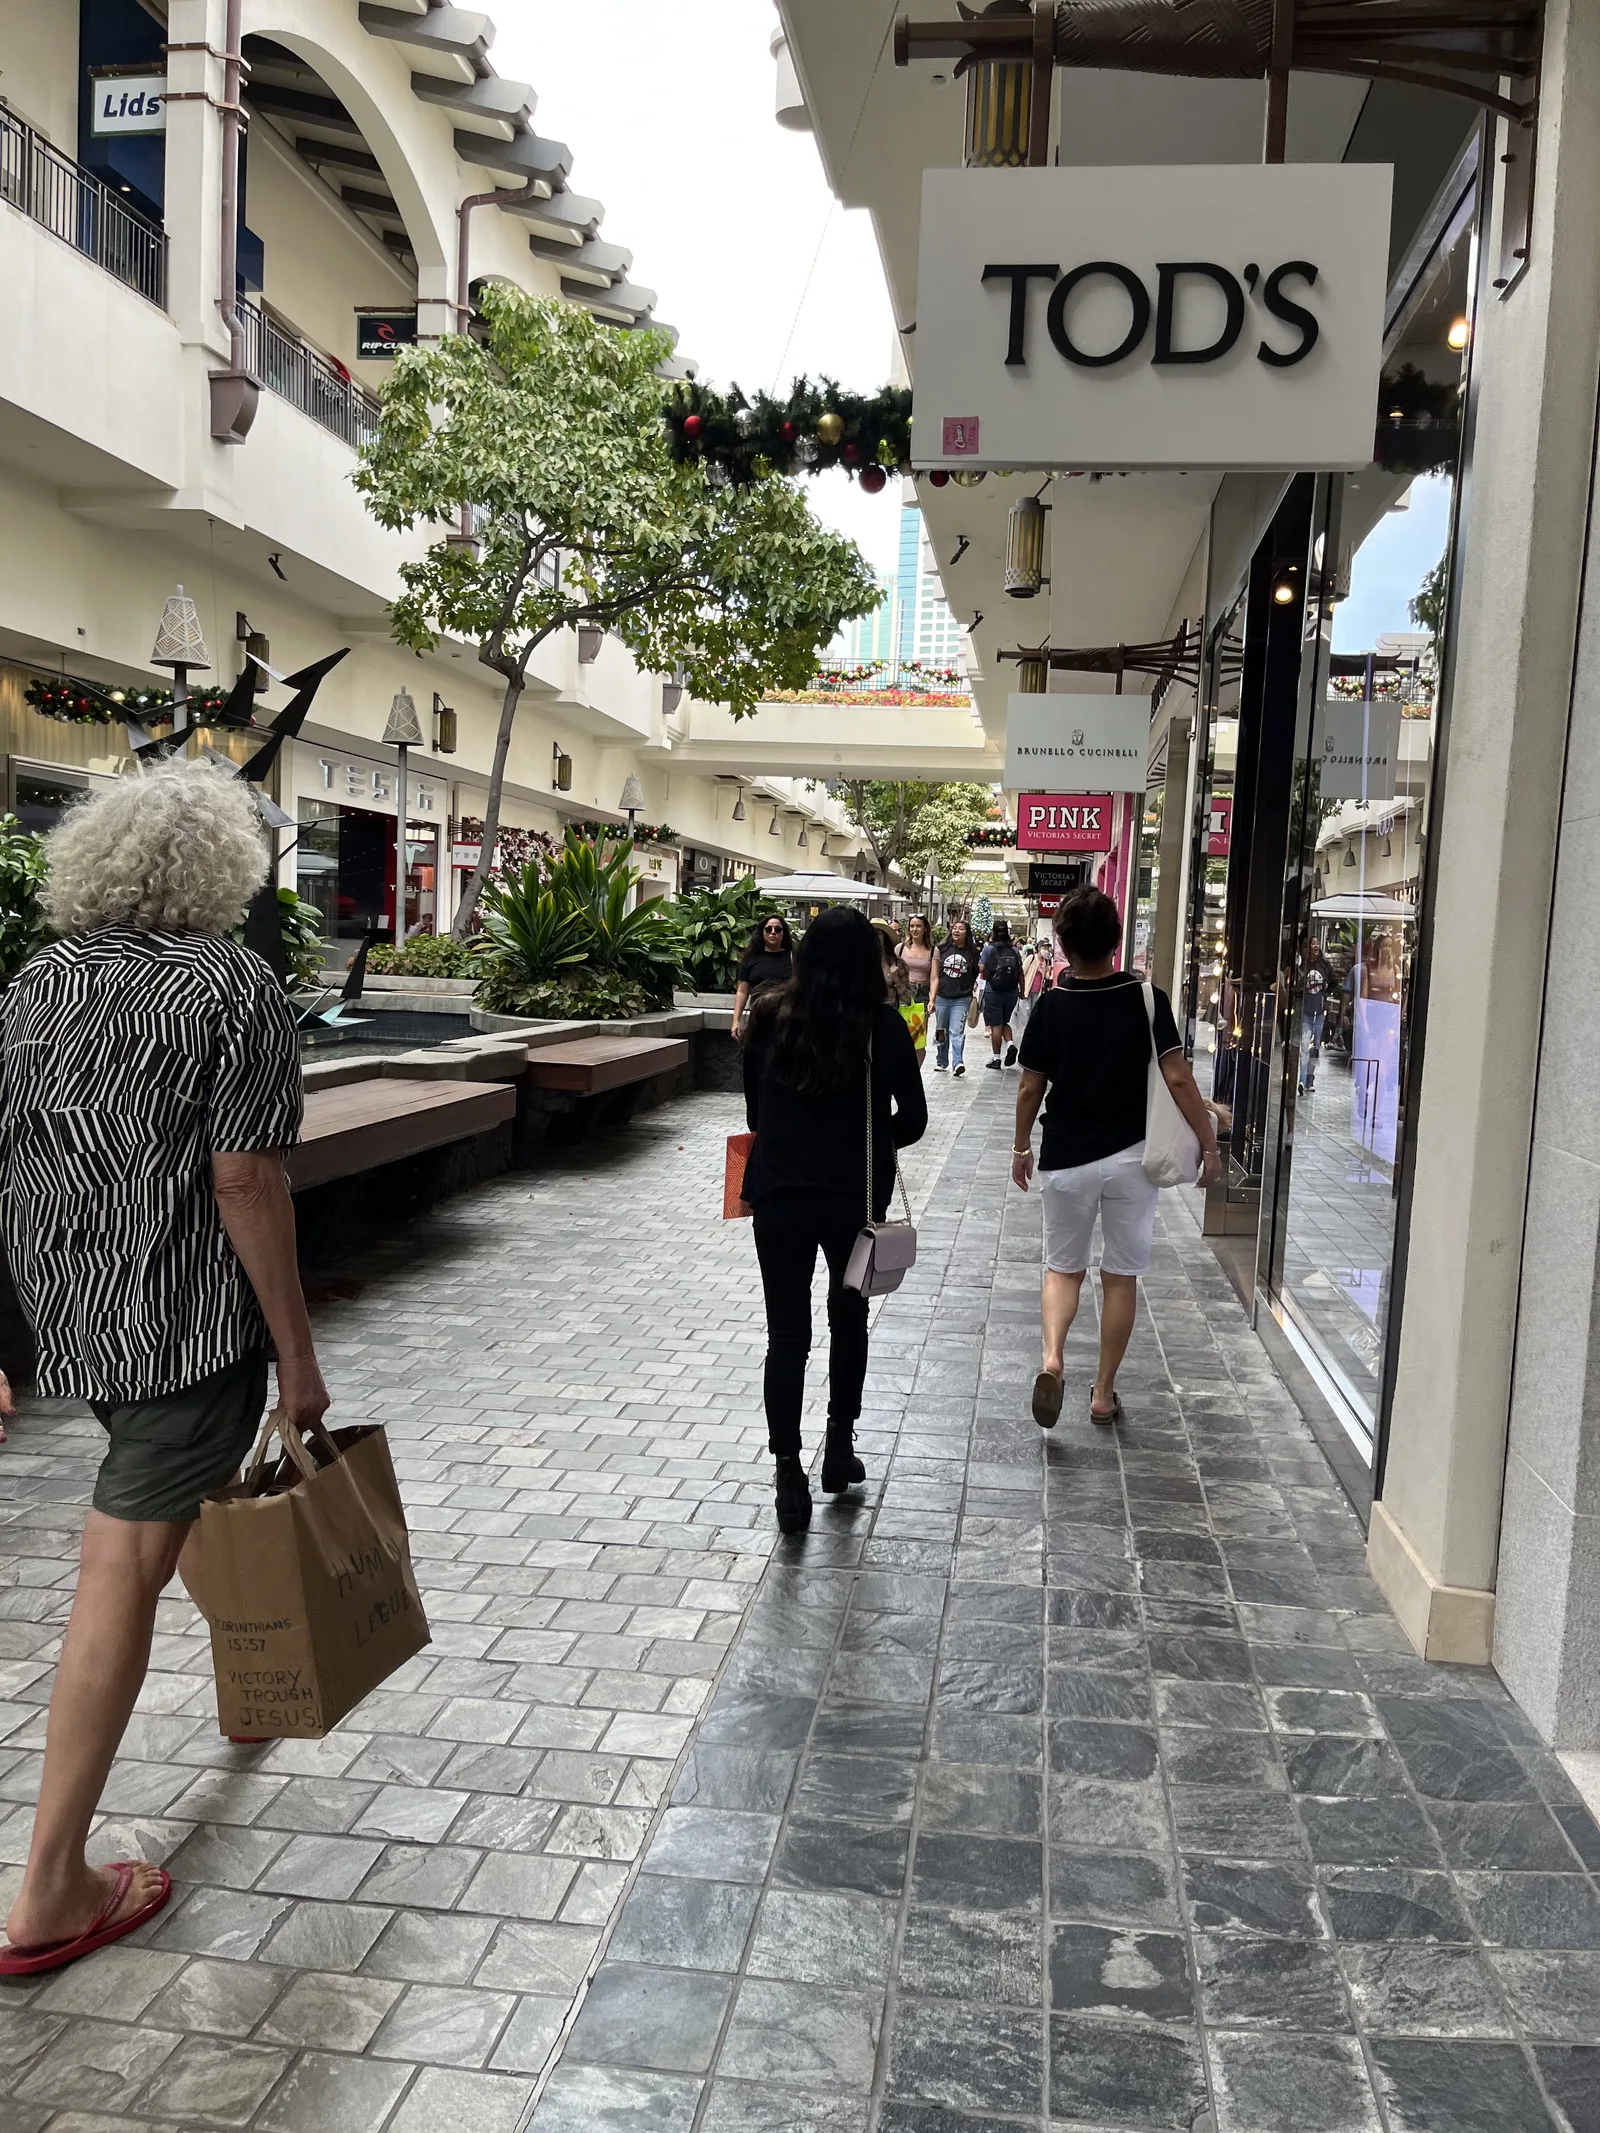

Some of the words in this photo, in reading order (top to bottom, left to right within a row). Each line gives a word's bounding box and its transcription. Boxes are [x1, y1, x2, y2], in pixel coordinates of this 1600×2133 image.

[103, 91, 160, 117] Lids
[980, 260, 1319, 367] TOD'S
[361, 342, 383, 350] RIP
[1017, 747, 1075, 756] BRUNELLO
[1079, 748, 1138, 757] CUCINELLI
[1028, 805, 1102, 830] PINK
[1027, 831, 1071, 839] VICTORIA'S
[1073, 832, 1101, 840] SECRET
[1034, 871, 1076, 880] VICTORIA'S
[389, 884, 428, 893] TSLA
[1040, 879, 1067, 887] SECRET
[228, 1638, 266, 1652] 15:57
[228, 1669, 301, 1688] VICTORY
[241, 1687, 314, 1704] TROUGH
[239, 1705, 323, 1729] JESUS!
